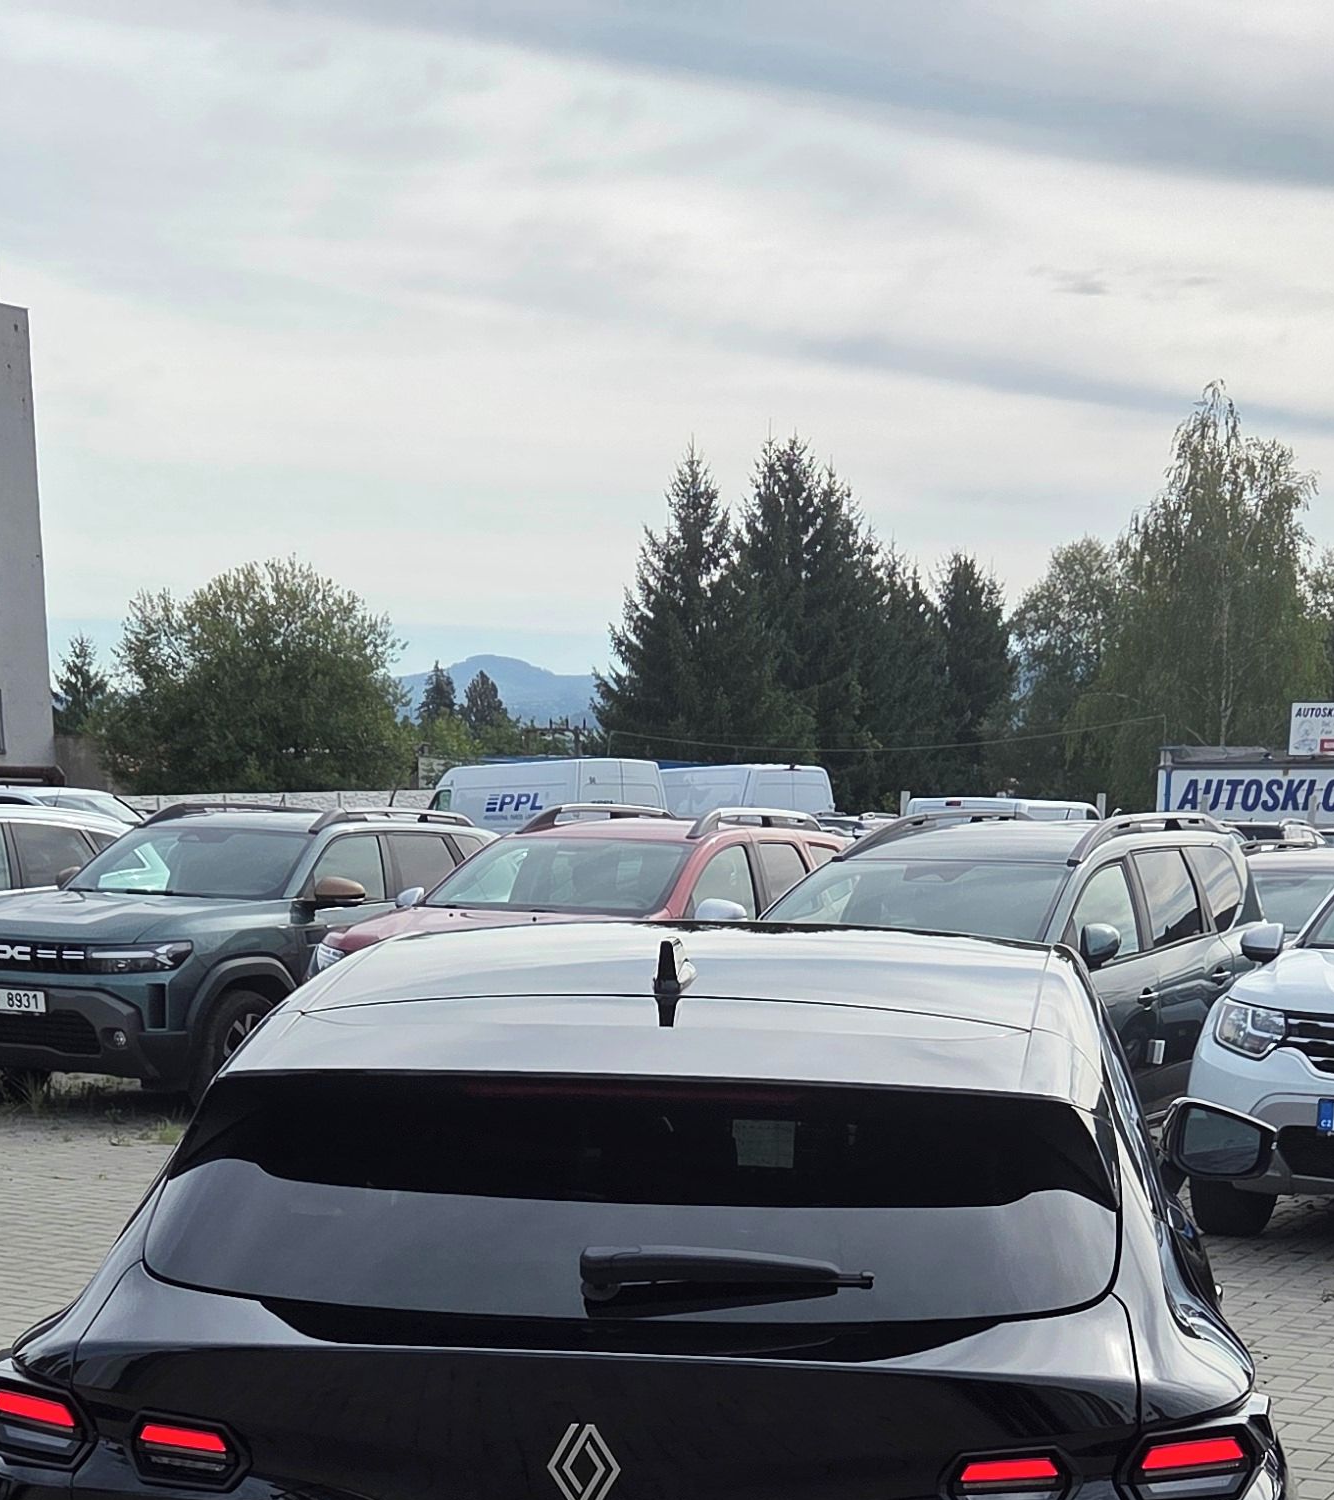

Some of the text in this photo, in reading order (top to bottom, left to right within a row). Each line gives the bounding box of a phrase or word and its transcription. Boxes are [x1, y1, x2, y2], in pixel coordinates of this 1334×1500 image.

[498, 792, 543, 813] PPL
[7, 992, 39, 1010] 8931
[1320, 1119, 1332, 1128] CZ
